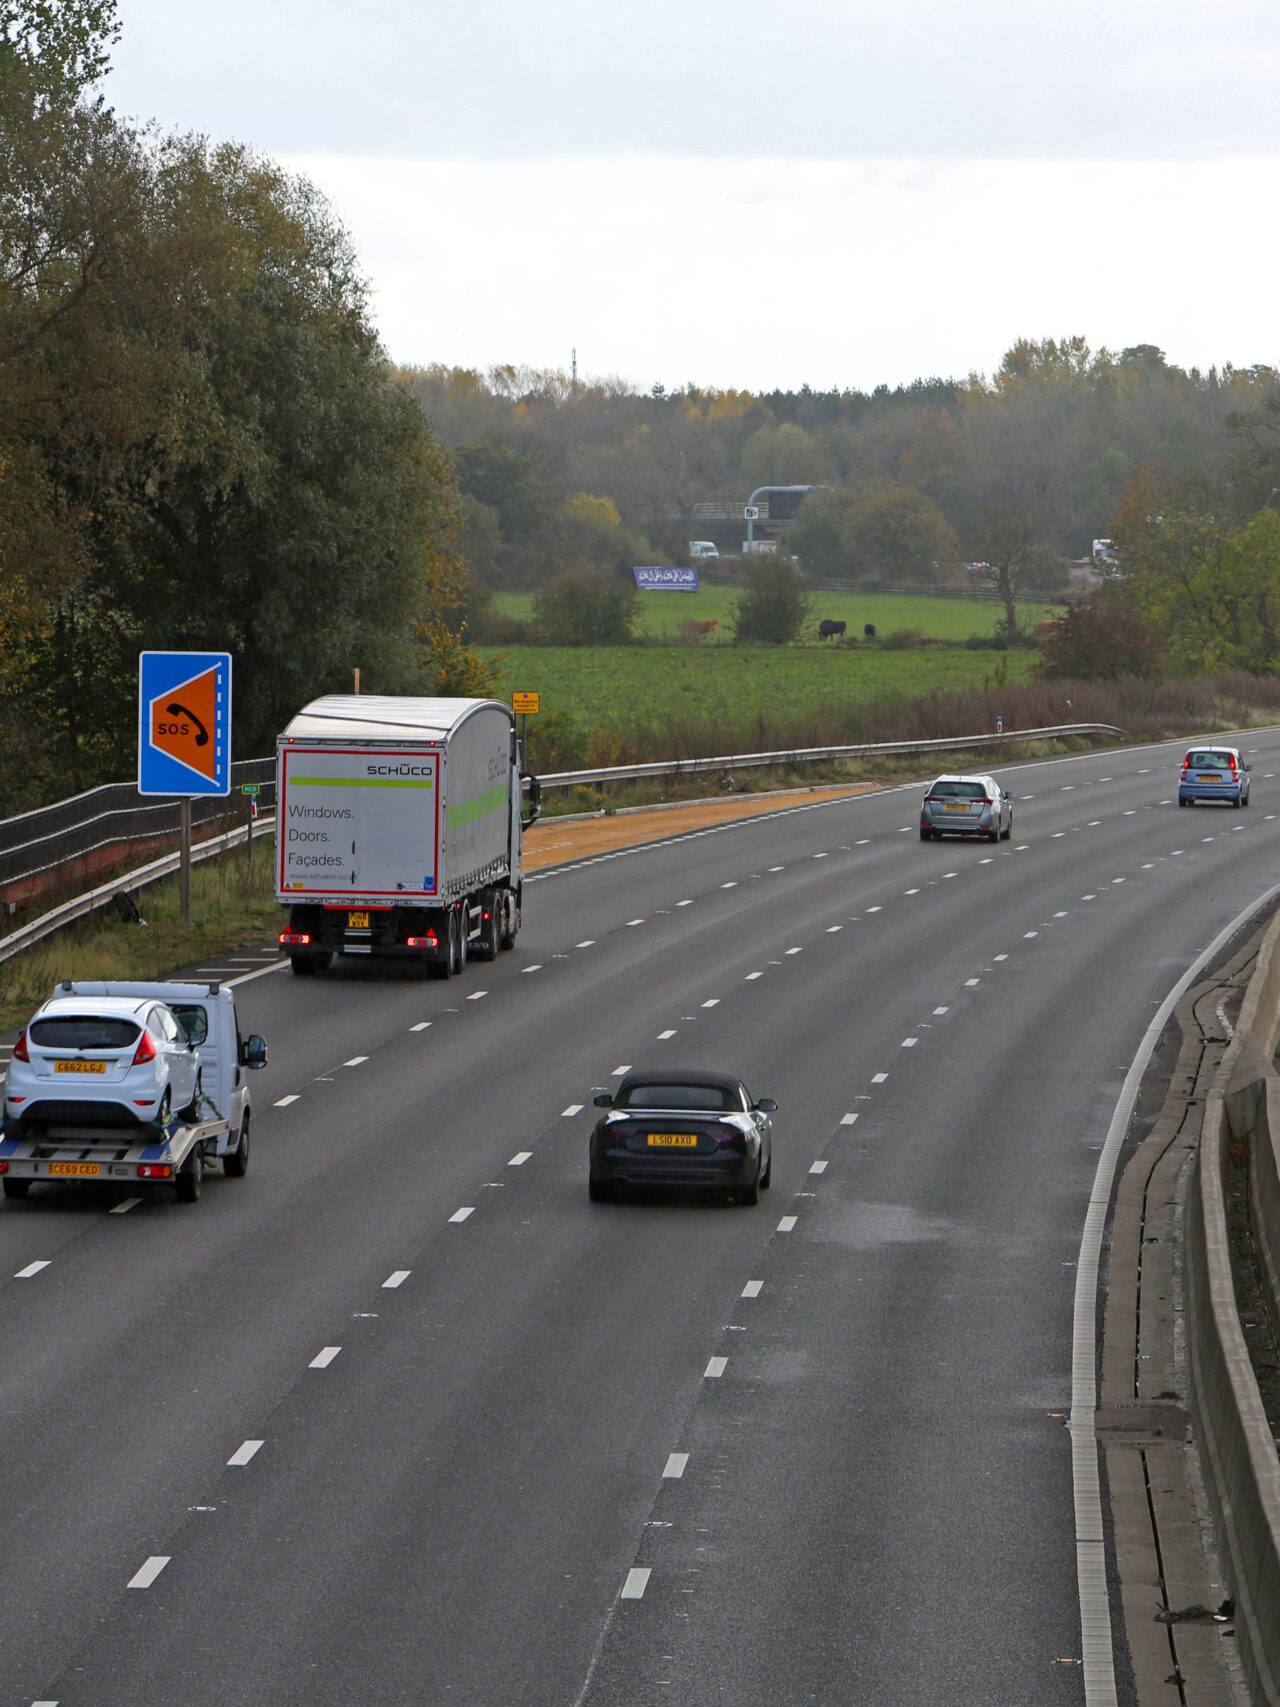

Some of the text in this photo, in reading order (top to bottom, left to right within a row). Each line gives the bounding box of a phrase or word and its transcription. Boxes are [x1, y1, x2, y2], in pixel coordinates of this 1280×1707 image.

[157, 723, 190, 735] SOS
[367, 763, 433, 776] SCHÜCO
[288, 805, 355, 819] Windows.
[288, 828, 331, 842] Doors.
[287, 852, 345, 868] Façades.
[58, 1062, 82, 1072] CE62
[53, 1164, 78, 1174] CE69
